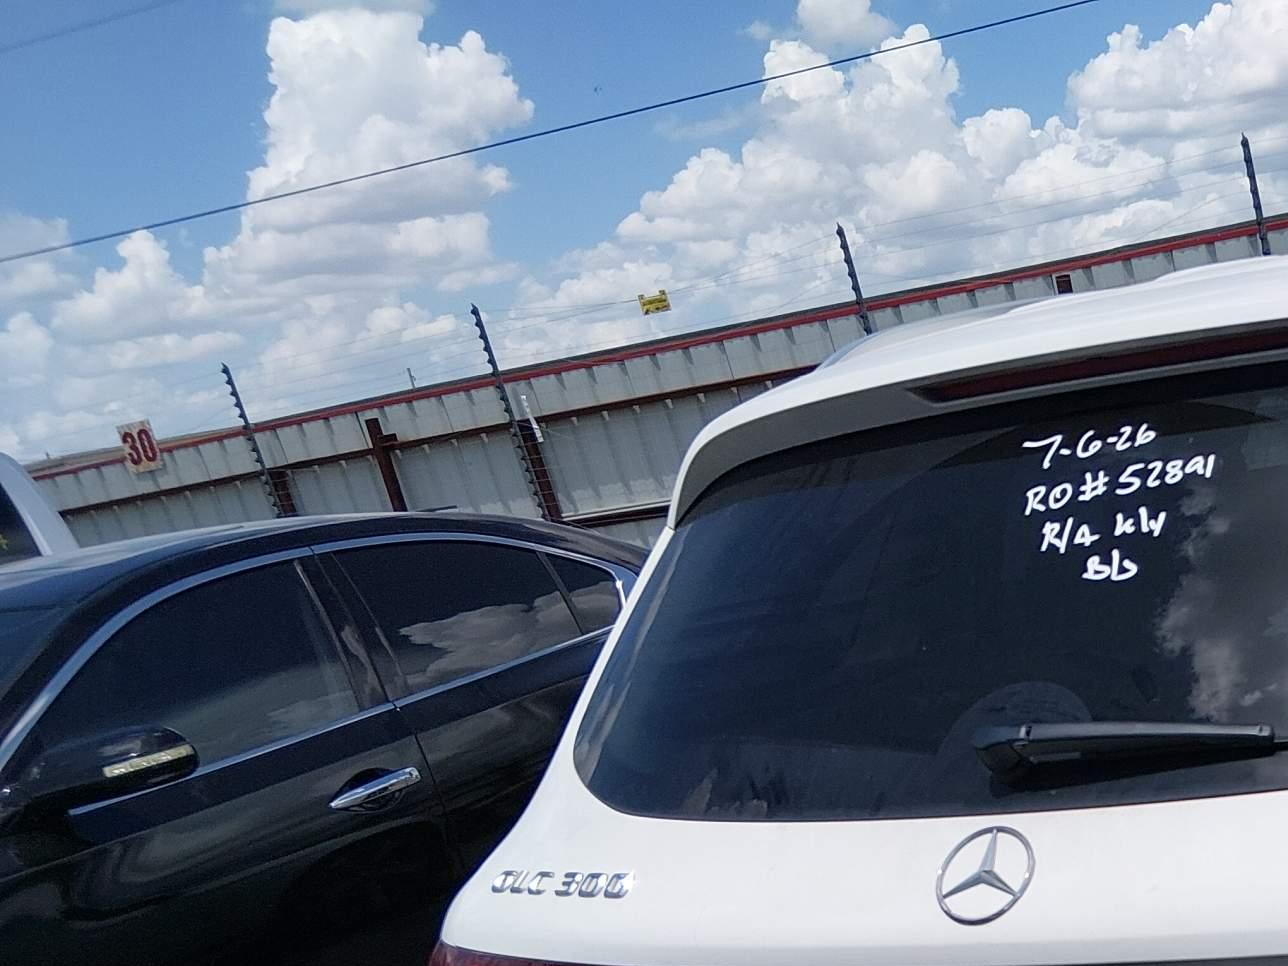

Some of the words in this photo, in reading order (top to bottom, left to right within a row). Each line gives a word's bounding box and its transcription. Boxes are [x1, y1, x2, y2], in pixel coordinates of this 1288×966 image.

[121, 428, 158, 466] 30
[1021, 423, 1157, 470] 7-6-26
[491, 869, 555, 895] GLC
[554, 871, 636, 899] 300
